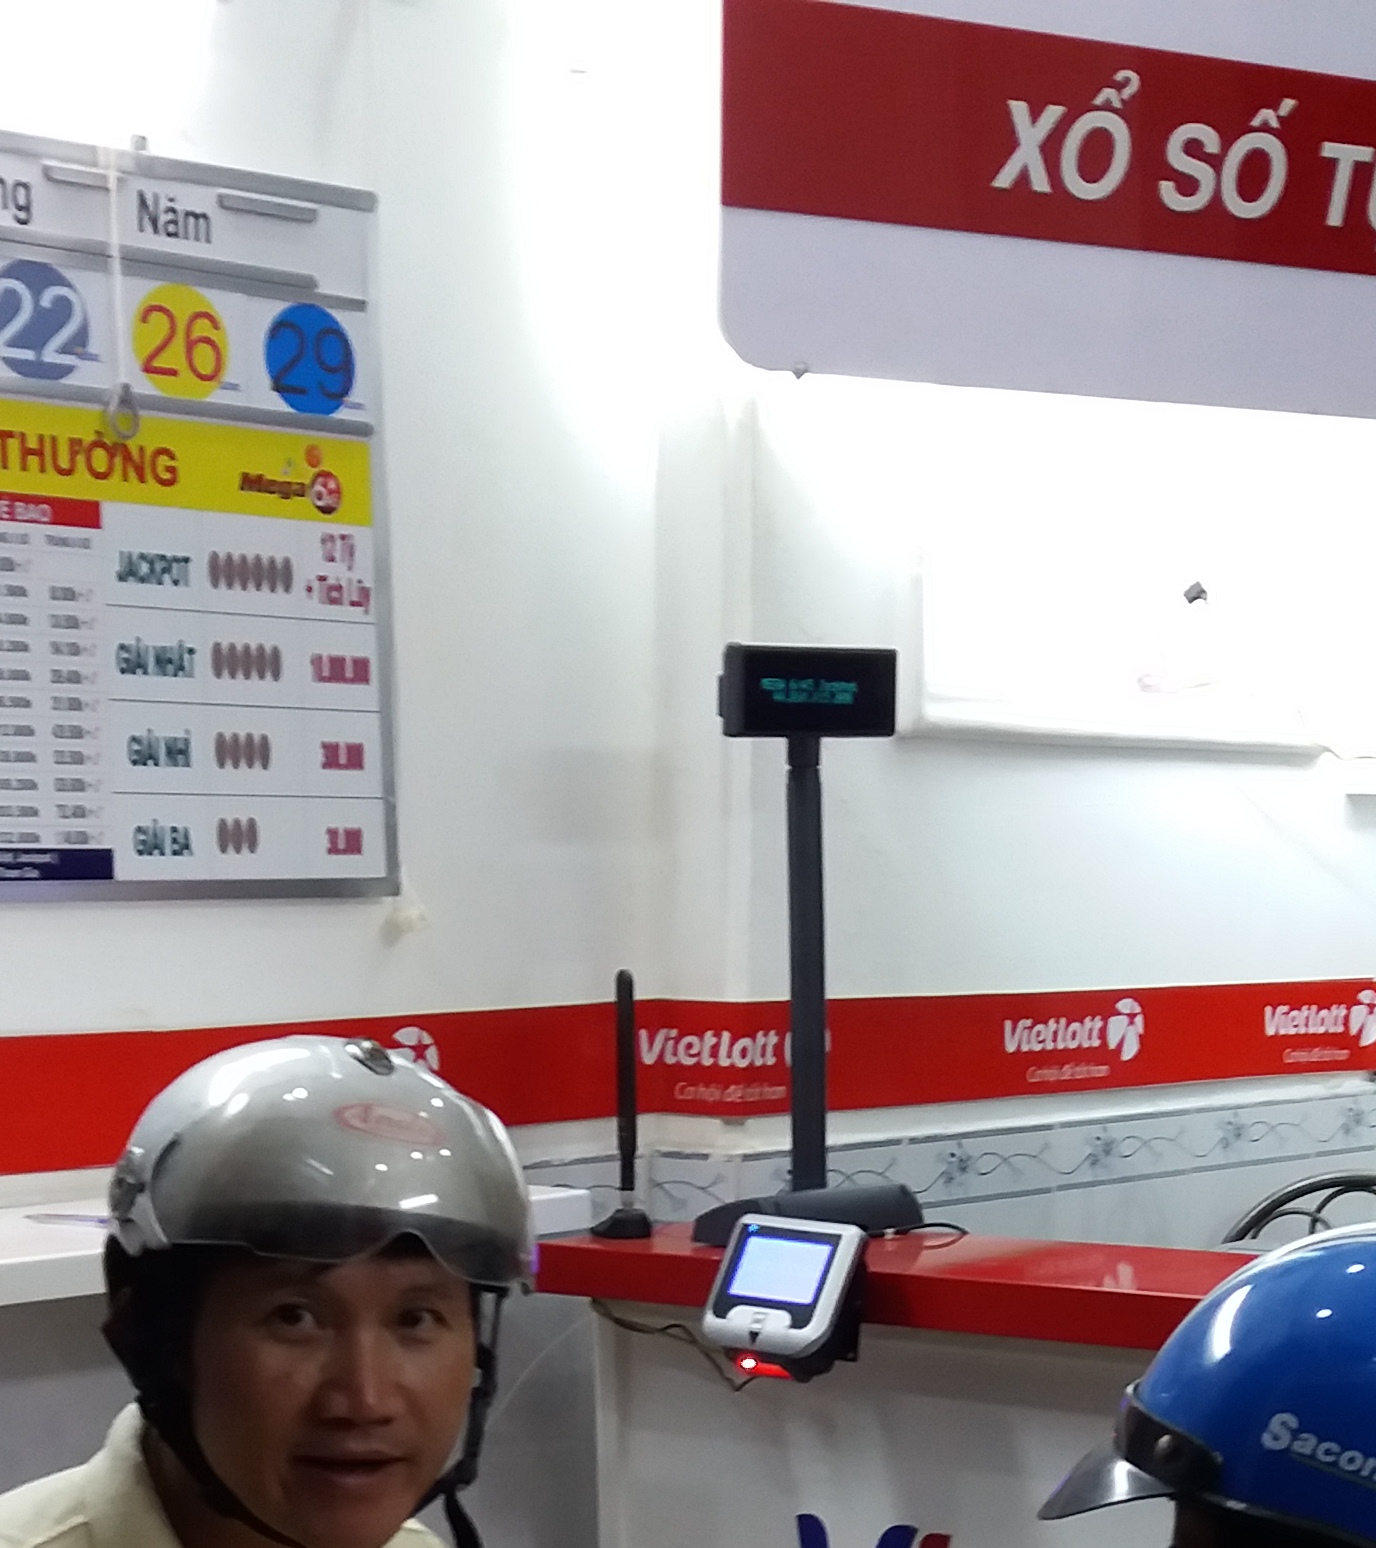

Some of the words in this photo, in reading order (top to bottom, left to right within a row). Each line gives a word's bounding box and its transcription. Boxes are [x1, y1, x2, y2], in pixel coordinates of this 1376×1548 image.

[990, 69, 1141, 201] XỔ
[1157, 97, 1299, 220] SỐ
[136, 189, 213, 244] Năm
[140, 304, 223, 383] 26
[268, 319, 355, 400] 29
[1004, 1015, 1104, 1053] Vietlott
[1264, 1004, 1349, 1037] Vietlott
[638, 1027, 779, 1068] Vietlott
